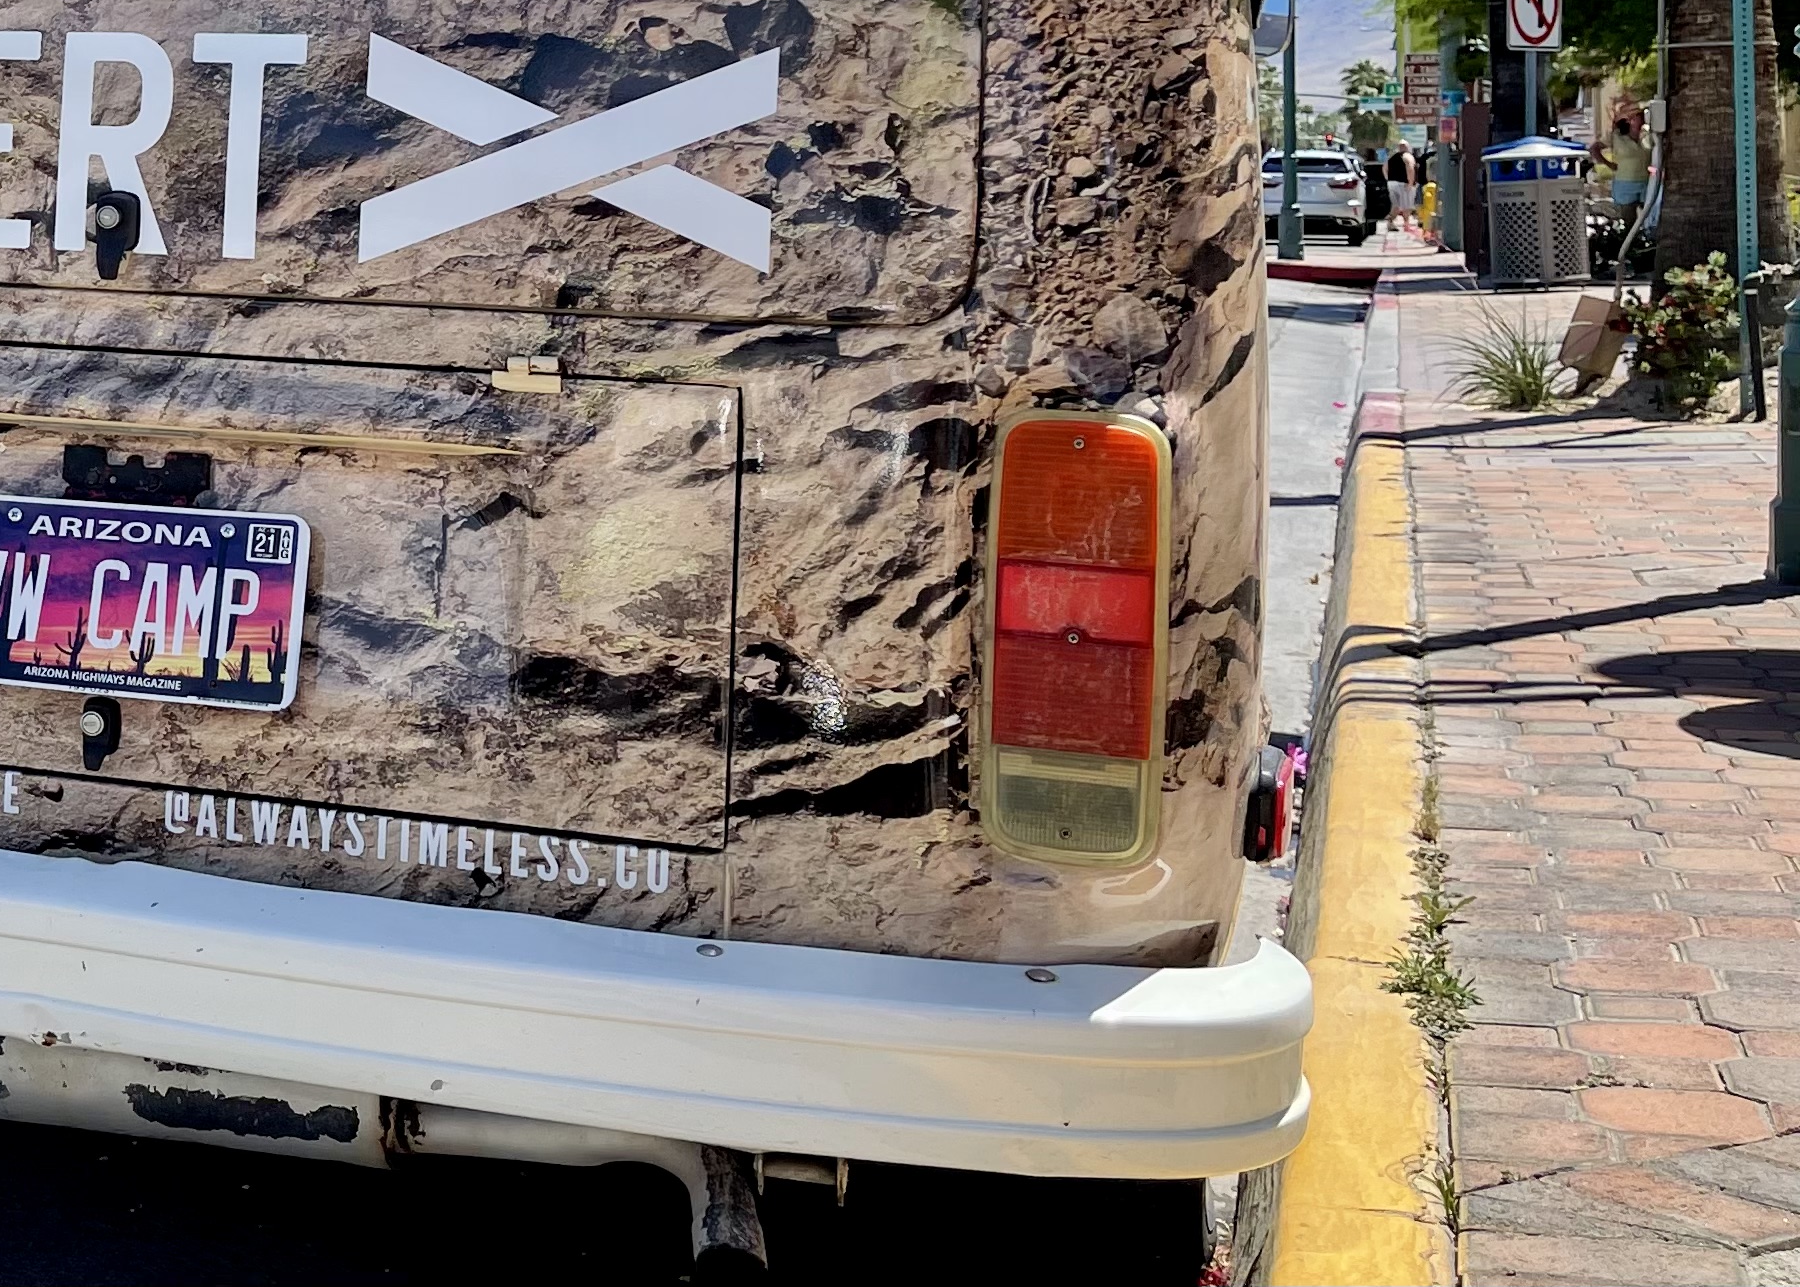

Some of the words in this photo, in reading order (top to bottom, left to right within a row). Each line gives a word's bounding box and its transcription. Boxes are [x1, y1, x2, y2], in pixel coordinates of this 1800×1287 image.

[28, 514, 212, 548] ARIZONA
[254, 532, 275, 553] 21
[281, 530, 290, 559] AUG
[87, 559, 261, 660] CAMP
[24, 665, 69, 680] ARIZONA
[71, 671, 125, 685] HIGHWAYS
[126, 676, 182, 691] MAGAZINE
[164, 789, 671, 894] @ALWAYSTIMELESS.CO
